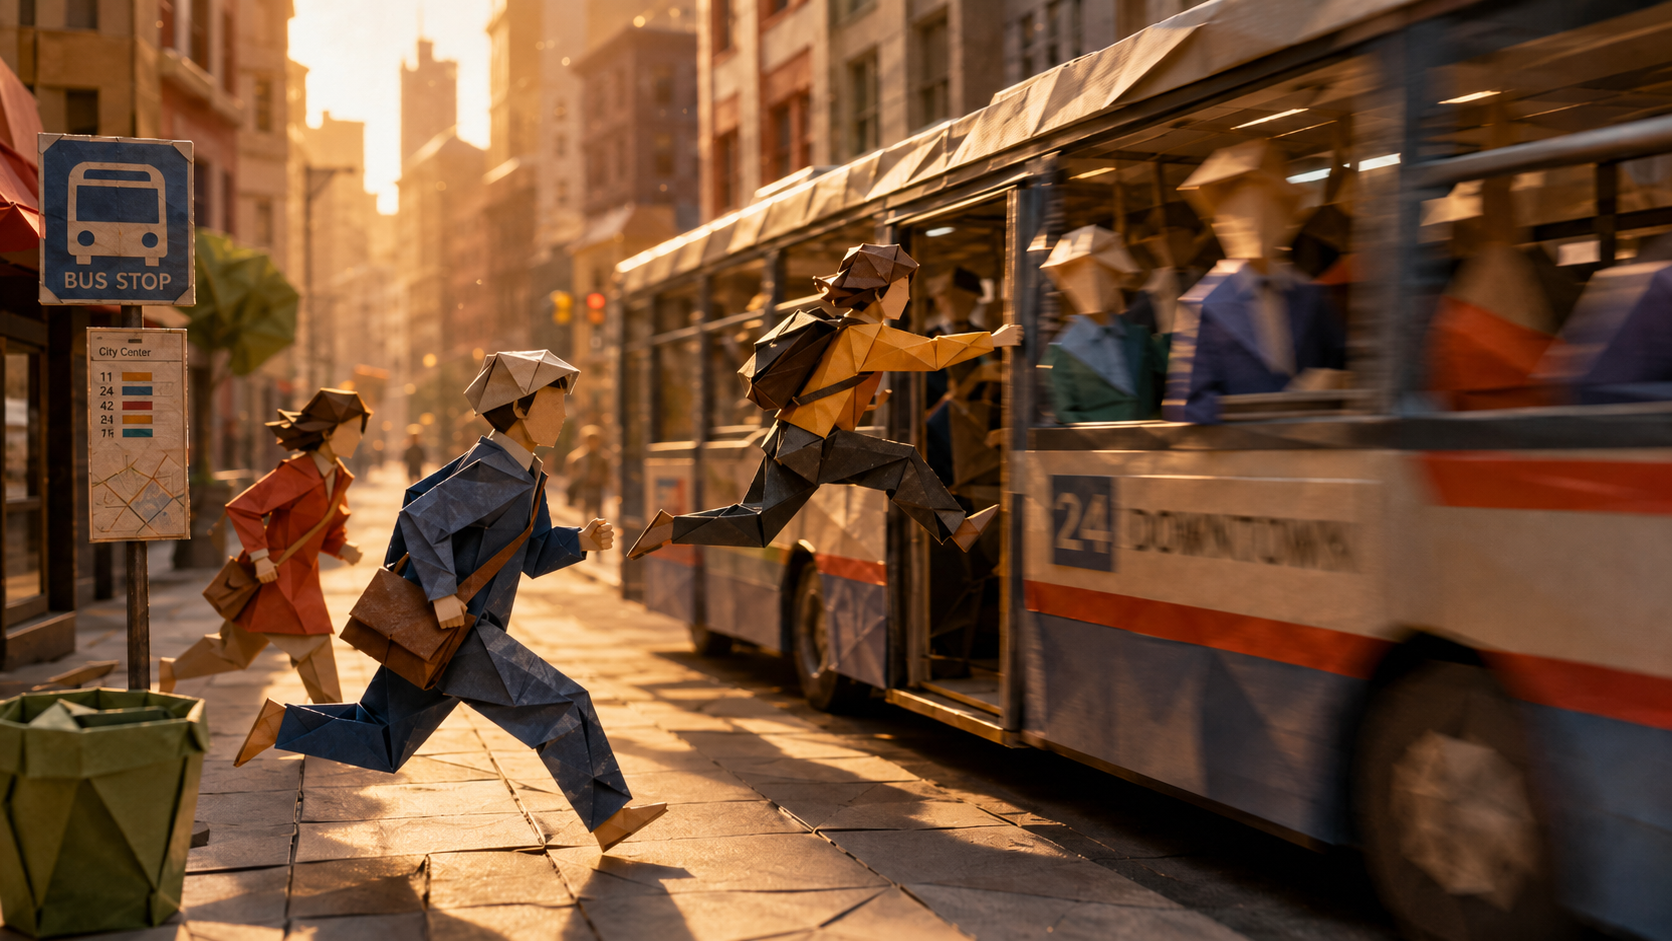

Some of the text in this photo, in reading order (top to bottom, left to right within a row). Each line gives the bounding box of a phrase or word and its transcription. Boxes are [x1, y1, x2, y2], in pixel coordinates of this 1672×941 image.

[64, 271, 172, 291] BUS STOP
[99, 347, 152, 358] City Center
[100, 372, 112, 382] 11
[100, 386, 114, 396] 24
[100, 401, 114, 411] 42
[1053, 491, 1113, 555] 24
